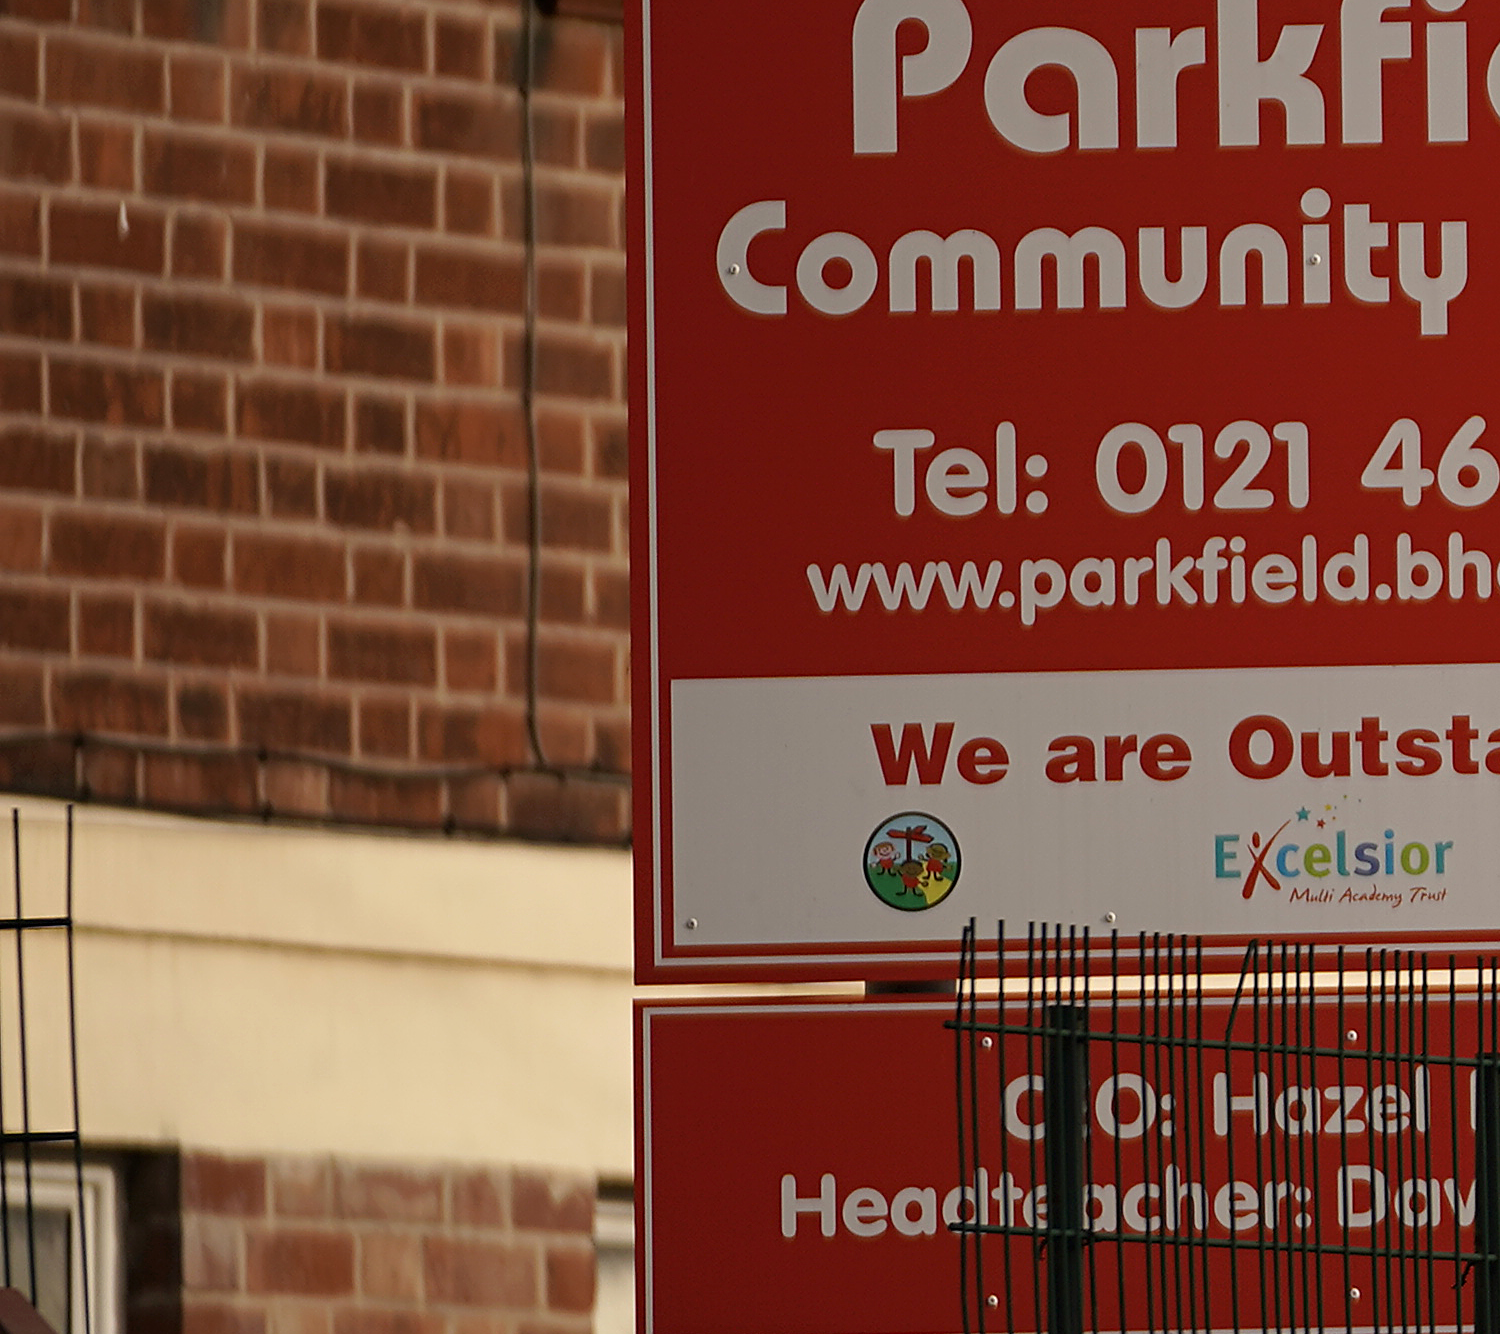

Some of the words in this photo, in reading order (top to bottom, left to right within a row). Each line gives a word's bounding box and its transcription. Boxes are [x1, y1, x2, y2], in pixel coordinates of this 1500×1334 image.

[715, 187, 1469, 336] Community
[872, 421, 1049, 517] Tel:
[1095, 420, 1311, 514] 0121
[870, 721, 1010, 786] We
[1045, 734, 1192, 784] are
[1289, 888, 1333, 904] Multi
[1339, 884, 1403, 908] Academy
[1409, 886, 1448, 903] Trust
[1004, 1073, 1174, 1141] CO:
[1213, 1065, 1431, 1137] Hazel
[780, 1163, 1312, 1238] Headteacher:
